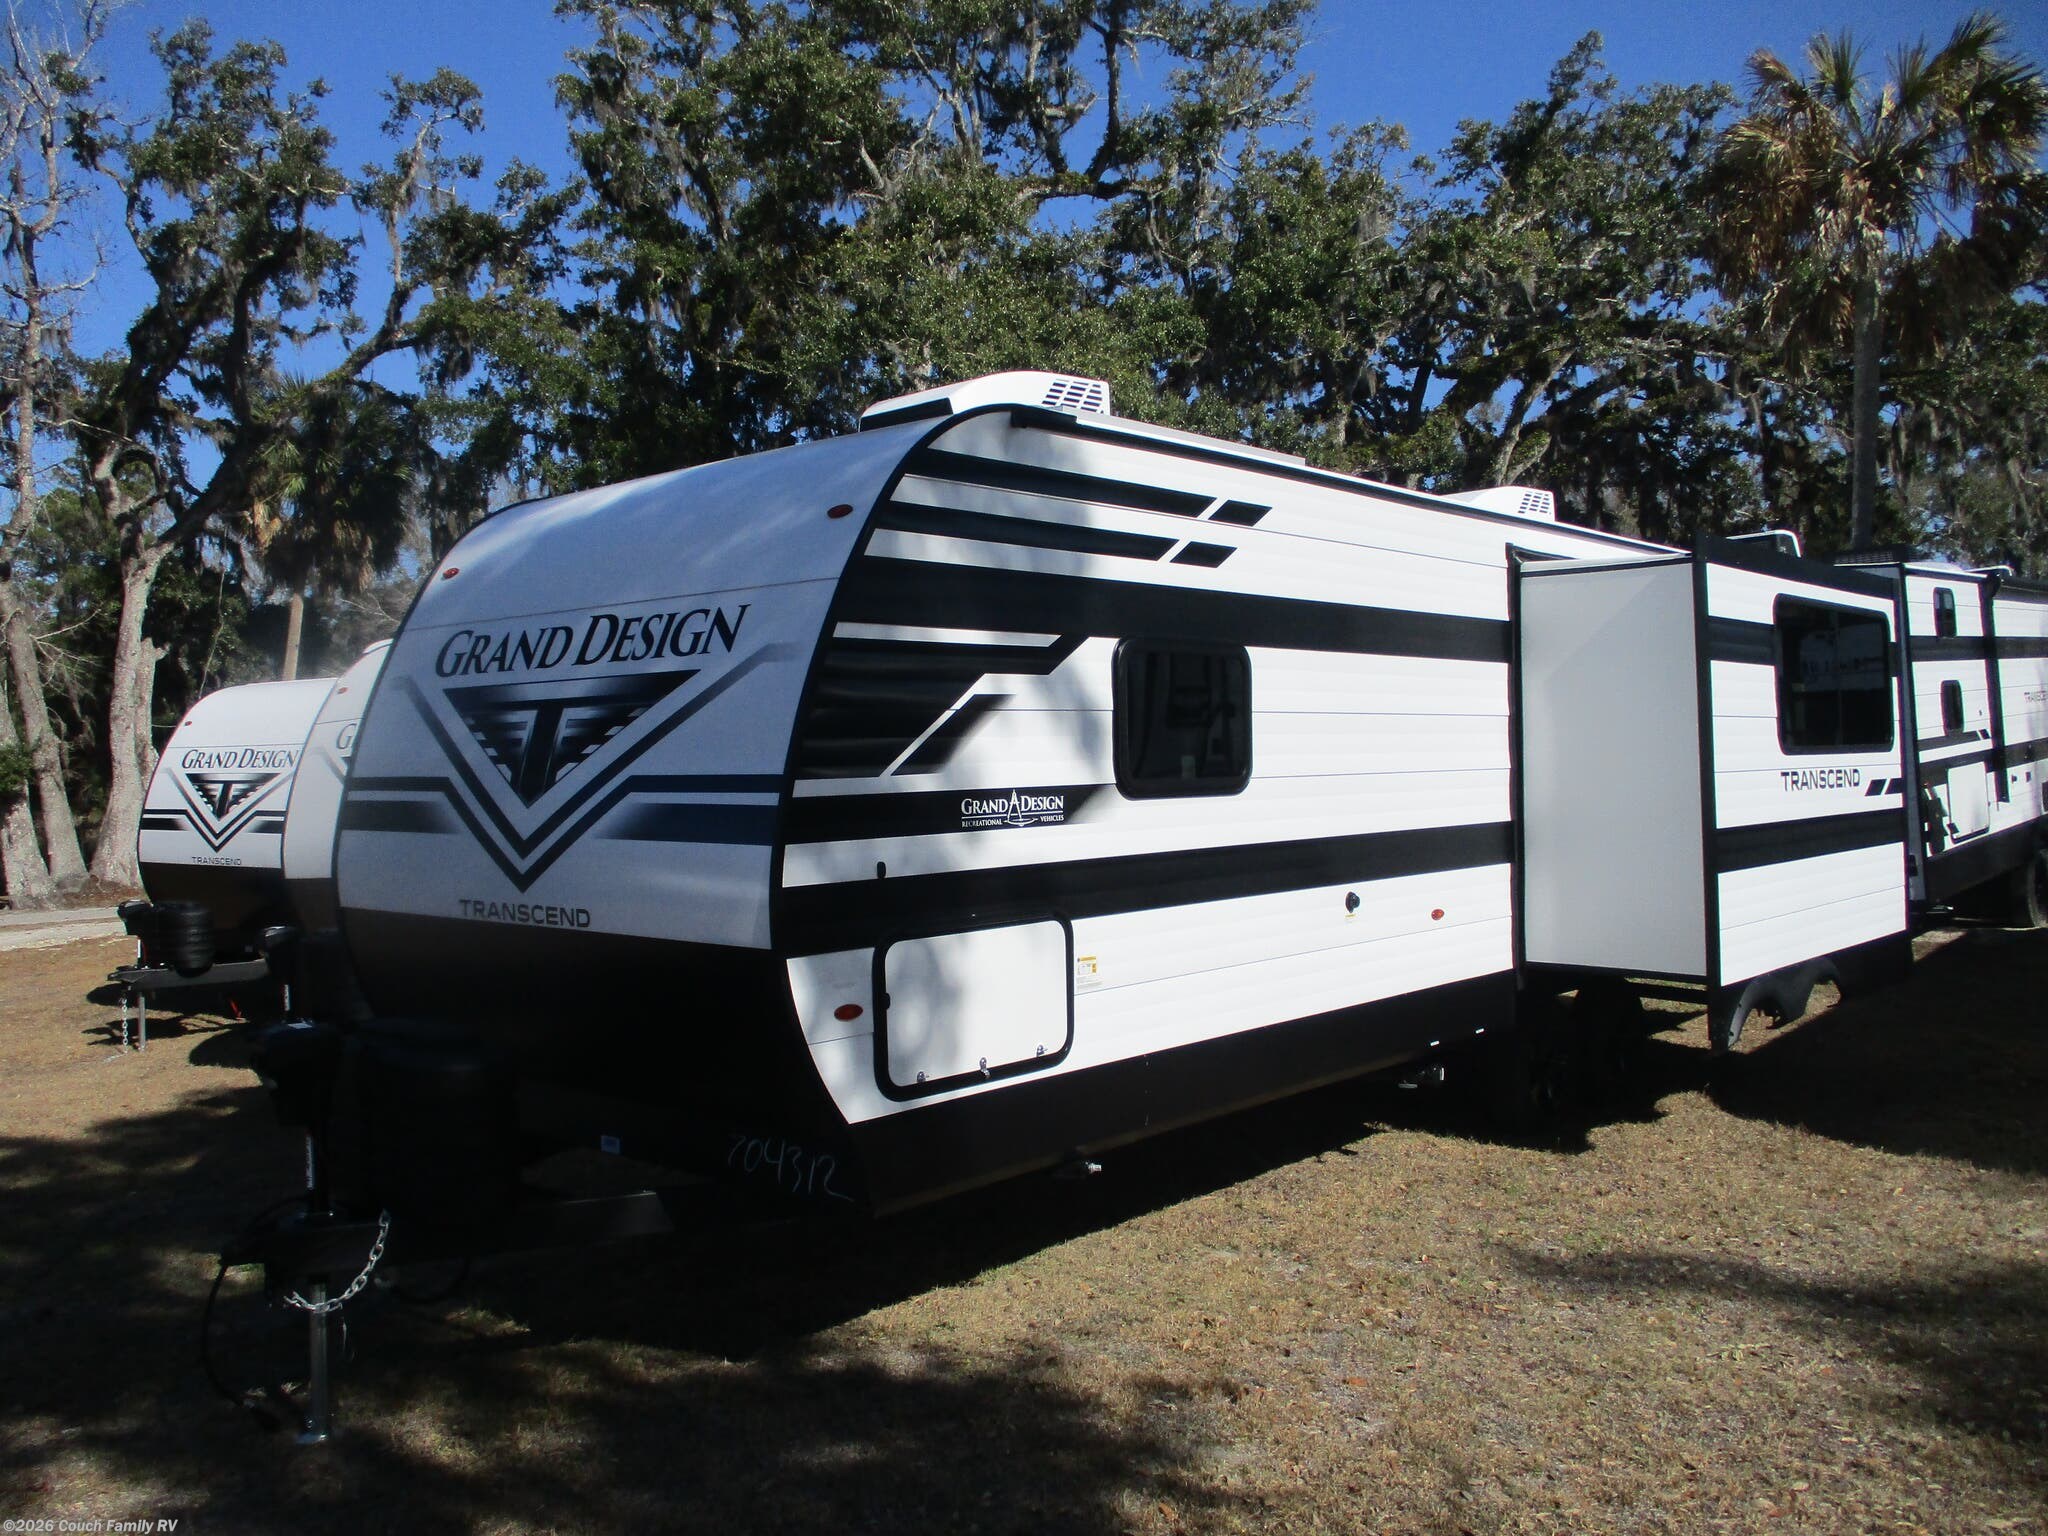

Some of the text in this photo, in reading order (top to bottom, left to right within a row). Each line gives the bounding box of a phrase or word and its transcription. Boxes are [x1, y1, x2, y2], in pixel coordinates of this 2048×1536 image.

[435, 603, 752, 678] GRAND DESIGN
[181, 748, 299, 769] GRAND DESIGN
[1780, 768, 1861, 792] TRANSCEND
[961, 795, 1064, 815] GRAND DESIGN
[961, 814, 1064, 828] RECREATIONAL VEHICLES
[191, 856, 242, 866] TRANSCEND
[458, 899, 591, 928] TRANSCEND
